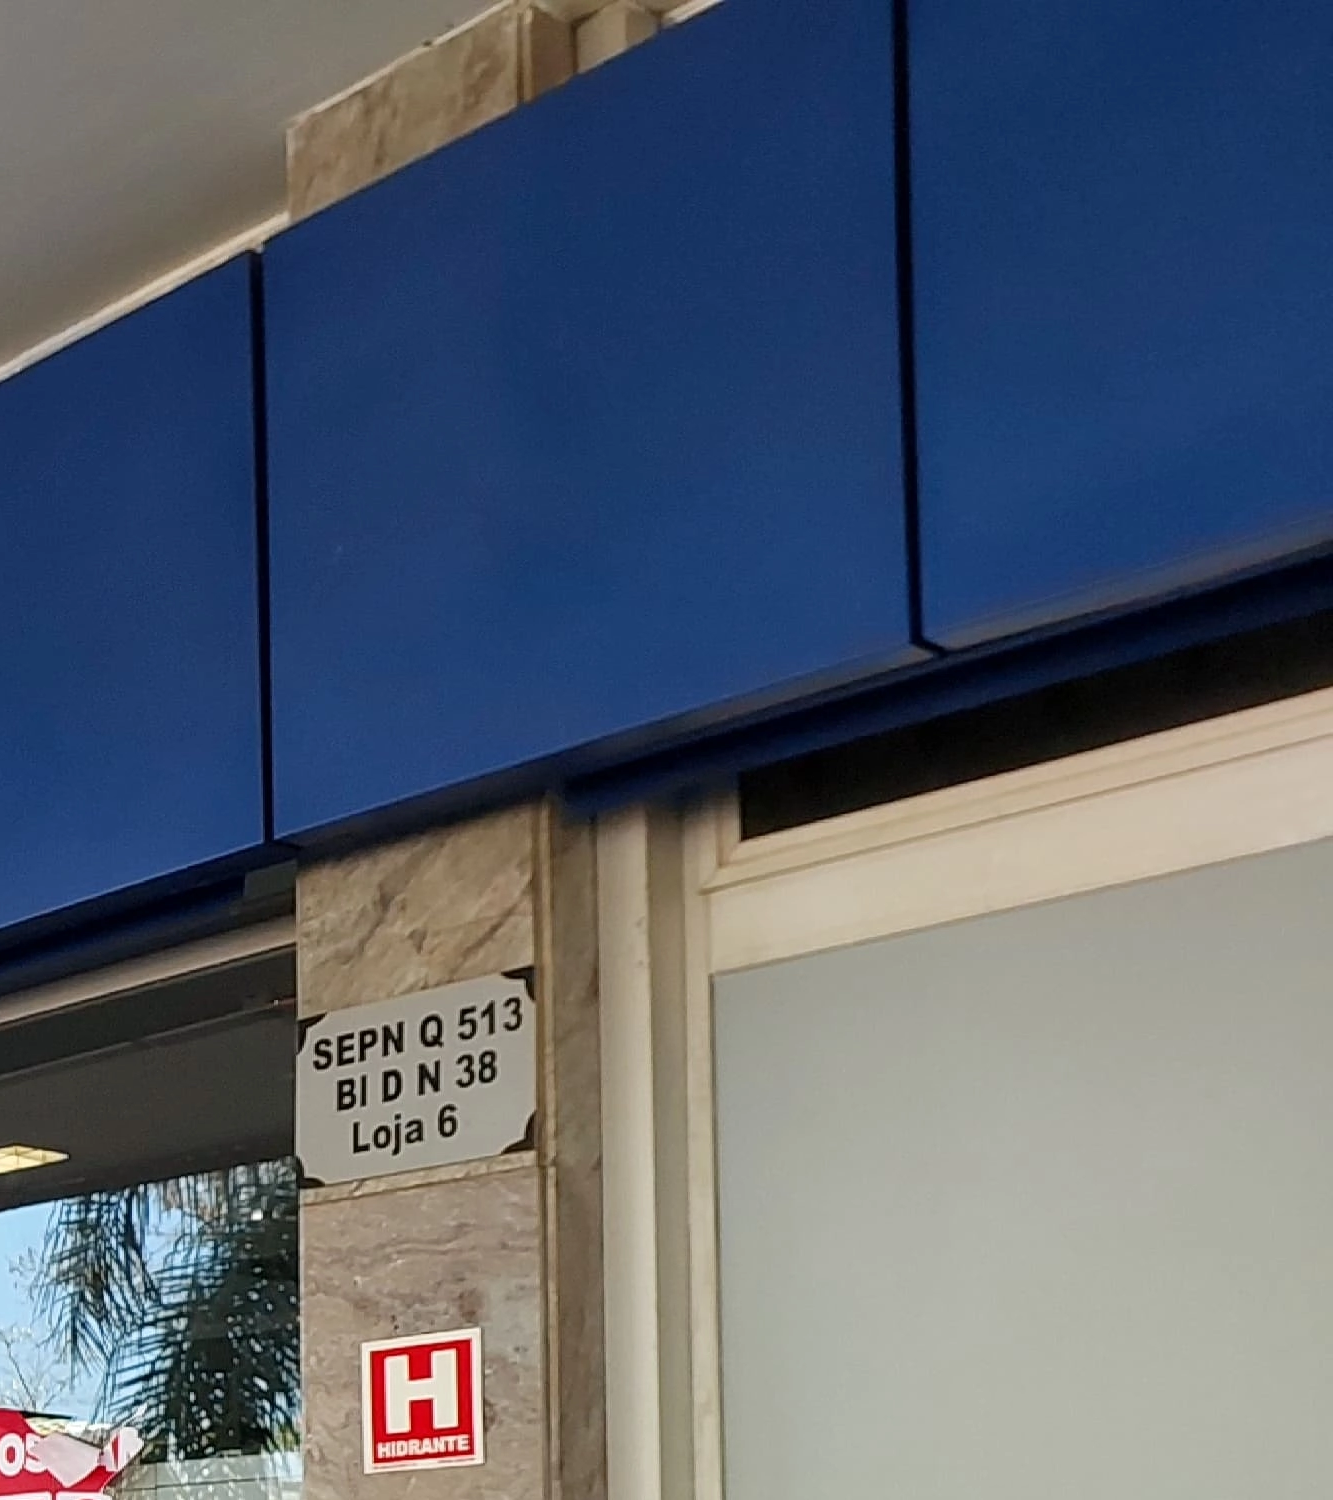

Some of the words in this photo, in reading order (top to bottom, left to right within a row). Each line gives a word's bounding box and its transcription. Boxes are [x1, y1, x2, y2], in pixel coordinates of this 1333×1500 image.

[313, 1021, 405, 1071] SEPN
[420, 1013, 444, 1047] Q
[457, 997, 524, 1041] 513
[382, 1069, 402, 1103] D
[417, 1060, 441, 1096] N
[455, 1050, 497, 1088] 38
[352, 1113, 424, 1155] Loja
[438, 1104, 458, 1137] 6
[384, 1349, 459, 1435] H
[377, 1434, 470, 1459] HIDRANTE
